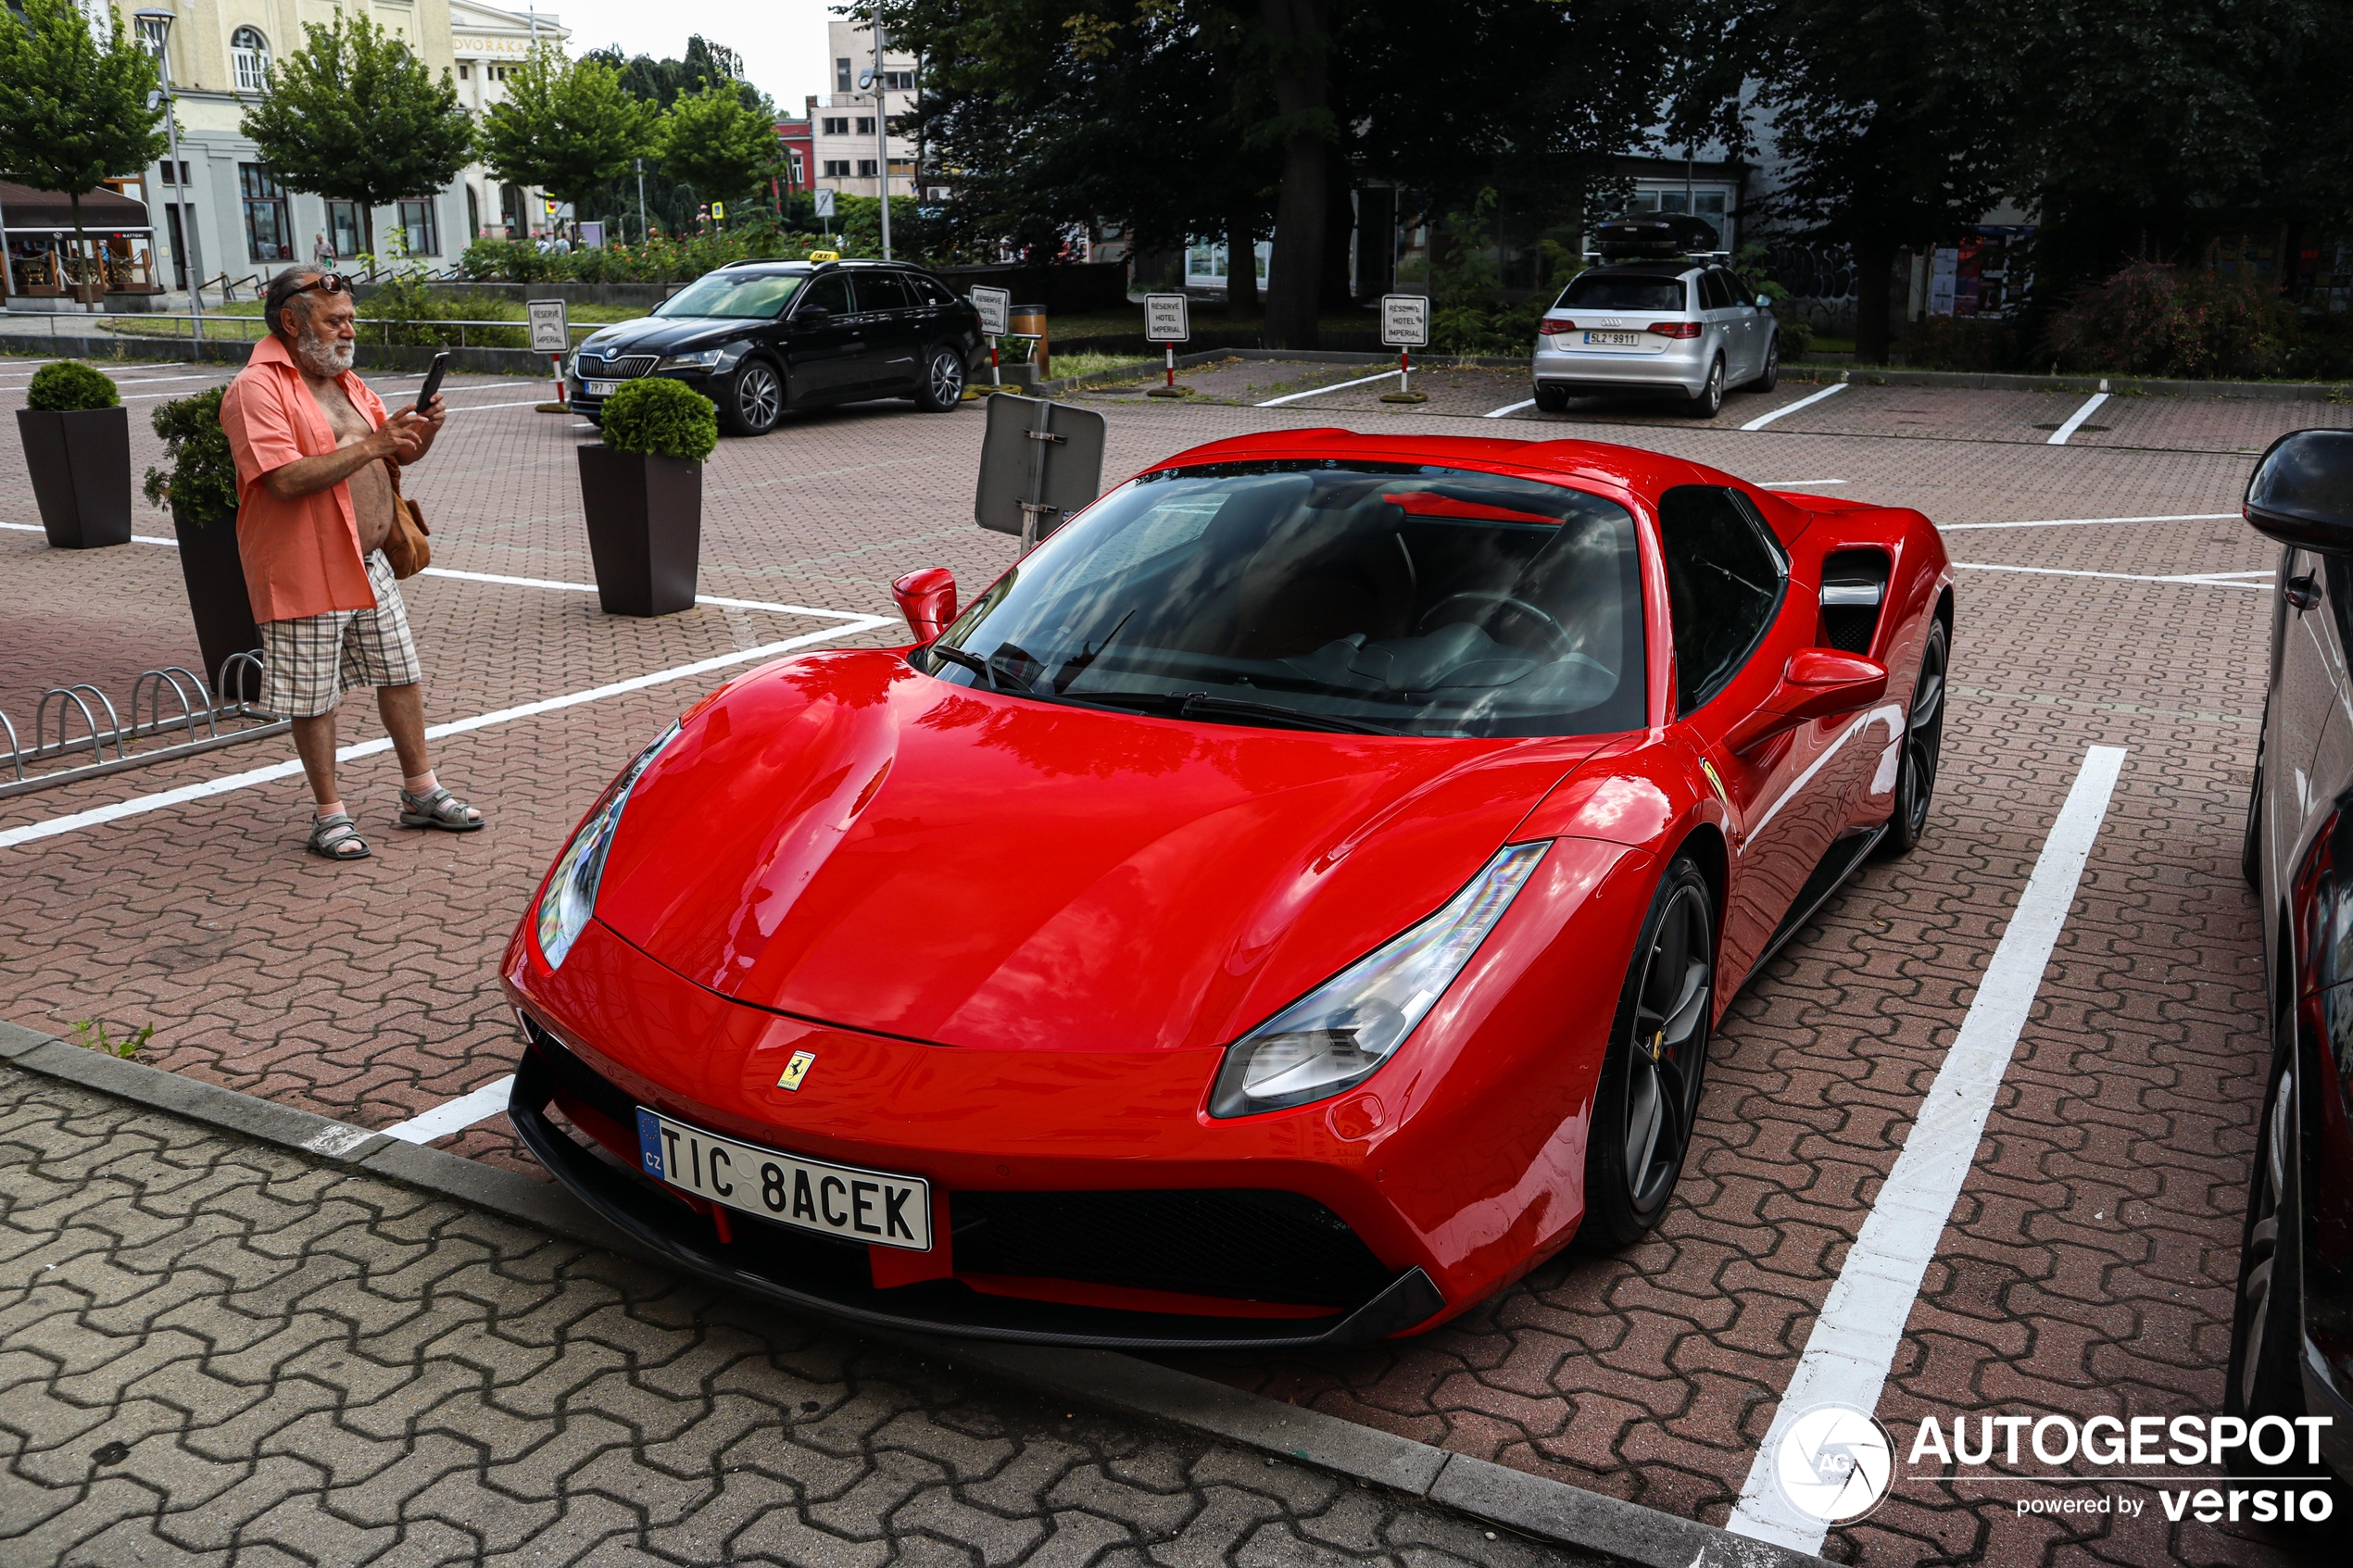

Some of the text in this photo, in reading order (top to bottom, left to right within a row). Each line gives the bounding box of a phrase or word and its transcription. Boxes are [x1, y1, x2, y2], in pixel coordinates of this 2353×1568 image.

[1592, 333, 1634, 344] 5L2 9911
[590, 383, 603, 393] 7P7
[646, 1151, 661, 1171] CZ
[661, 1126, 915, 1240] TIC 8ACEK
